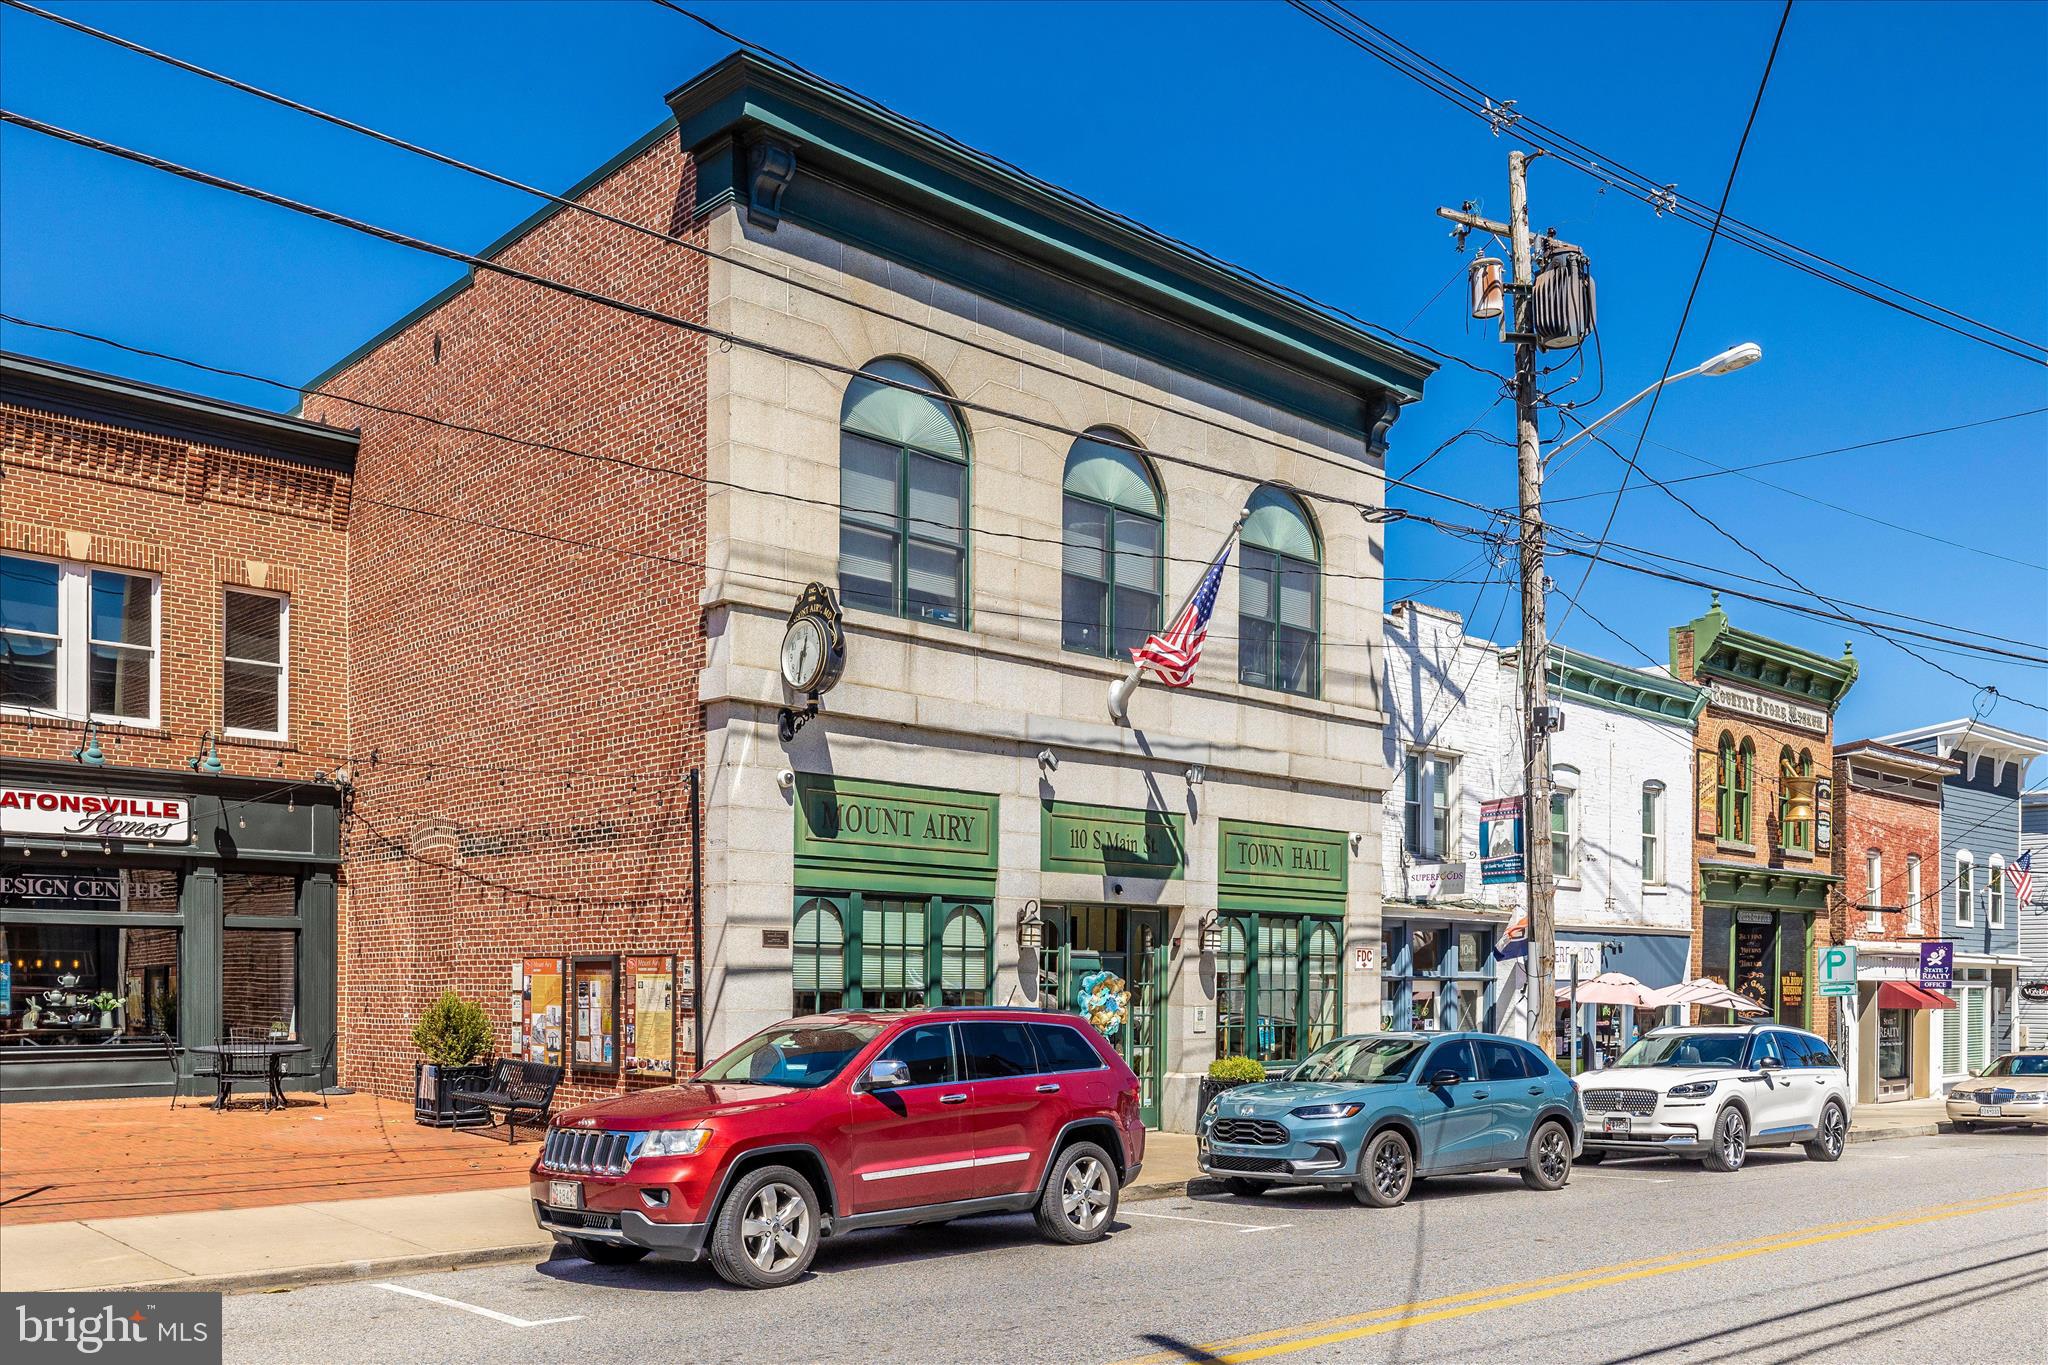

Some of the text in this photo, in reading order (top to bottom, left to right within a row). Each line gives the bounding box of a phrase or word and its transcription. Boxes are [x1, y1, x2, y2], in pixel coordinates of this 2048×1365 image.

[0, 791, 180, 819] ATONSVILLE
[64, 810, 172, 837] Homes
[822, 801, 976, 843] MOUNT AIRY
[1070, 828, 1087, 849] 110
[1105, 831, 1138, 853] Main
[1238, 842, 1330, 872] TOWN HALL
[1411, 871, 1464, 882] SUPERFOODS
[1356, 949, 1373, 962] FDC
[1827, 951, 1847, 979] P
[1880, 1026, 1899, 1038] REALTY
